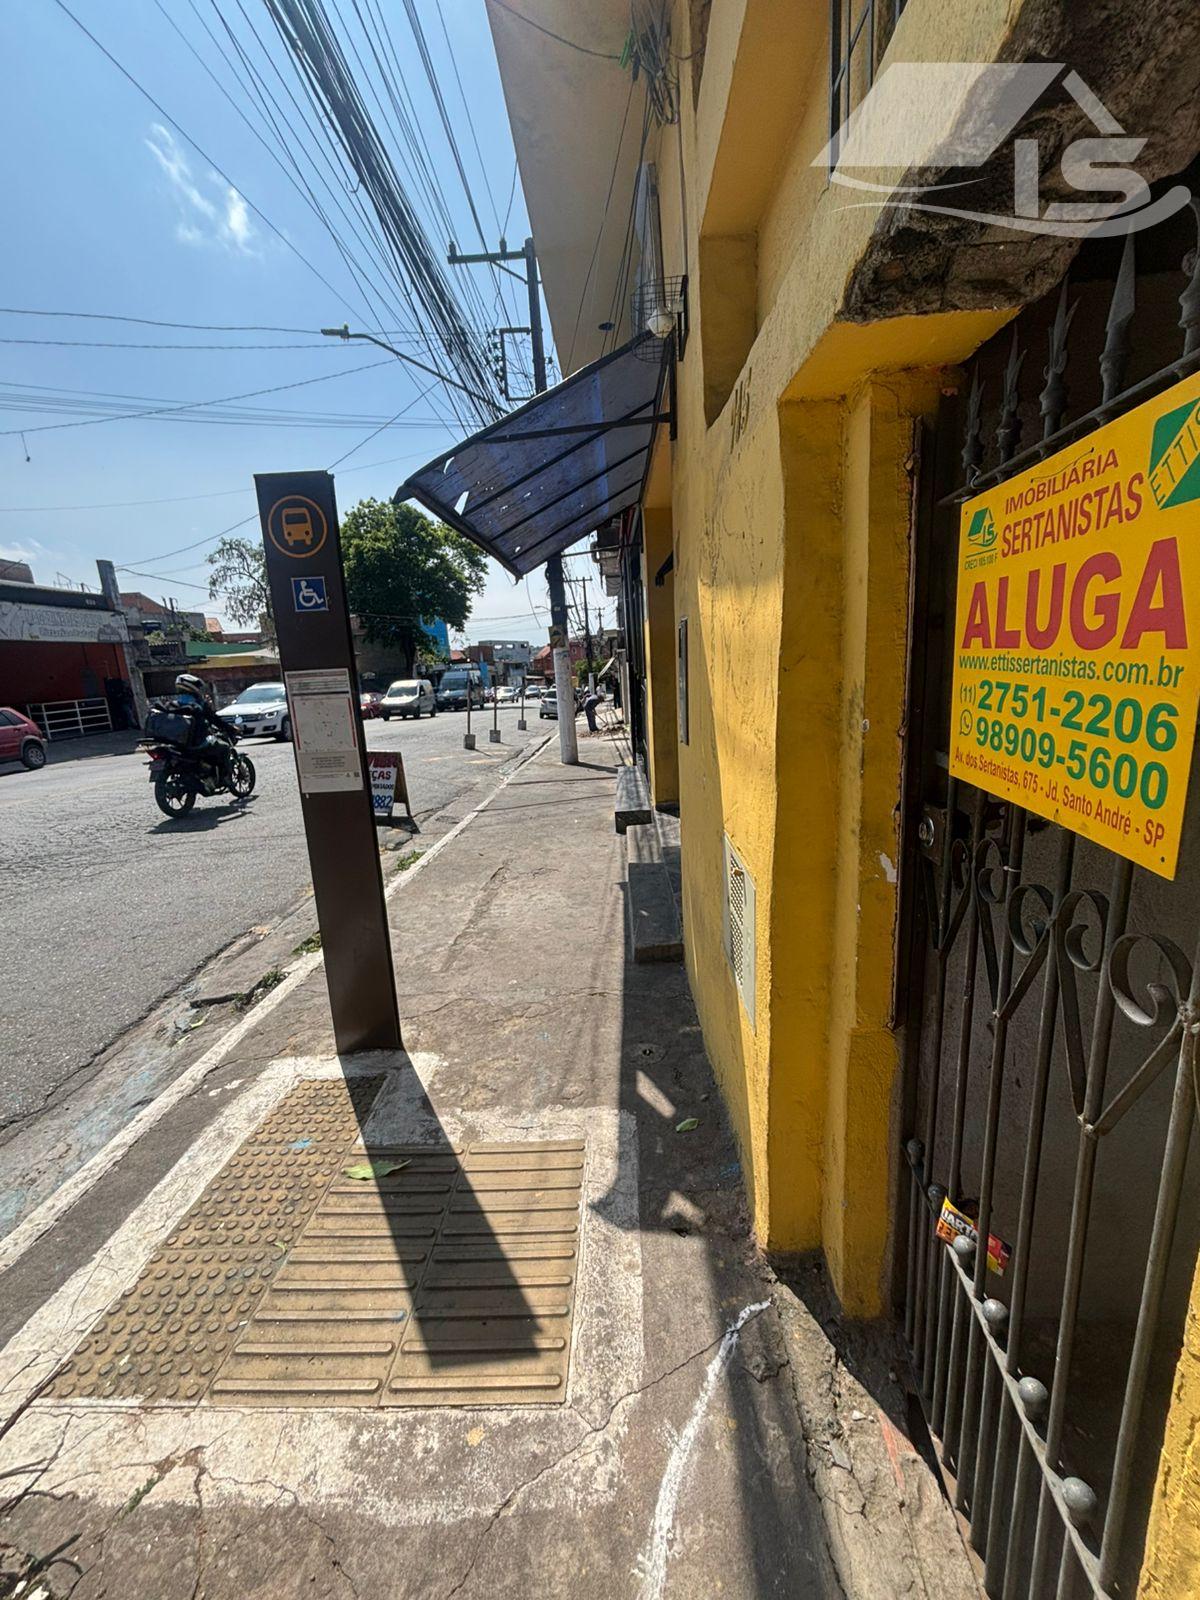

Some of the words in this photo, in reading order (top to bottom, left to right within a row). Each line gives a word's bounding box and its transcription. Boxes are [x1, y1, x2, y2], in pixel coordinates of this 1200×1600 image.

[1001, 472, 1144, 558] SERTANISTAS
[1005, 449, 1119, 515] IMOBILIÁRIA
[962, 537, 1188, 650] ALUGA
[959, 653, 1185, 688] www.ettissertanistas.com.br
[960, 683, 977, 705] (11)
[978, 679, 1179, 752] 2751-2206
[369, 770, 392, 781] ÇAS
[955, 747, 964, 764] Av.
[966, 751, 978, 768] dos
[979, 754, 1021, 789] Sertanistas,
[1023, 770, 1038, 793] 675
[1045, 779, 1059, 803] Jd.
[1062, 785, 1092, 817] Santo
[1095, 800, 1131, 835] André
[1143, 819, 1165, 848] SP
[976, 716, 1168, 809] 98909-5600
